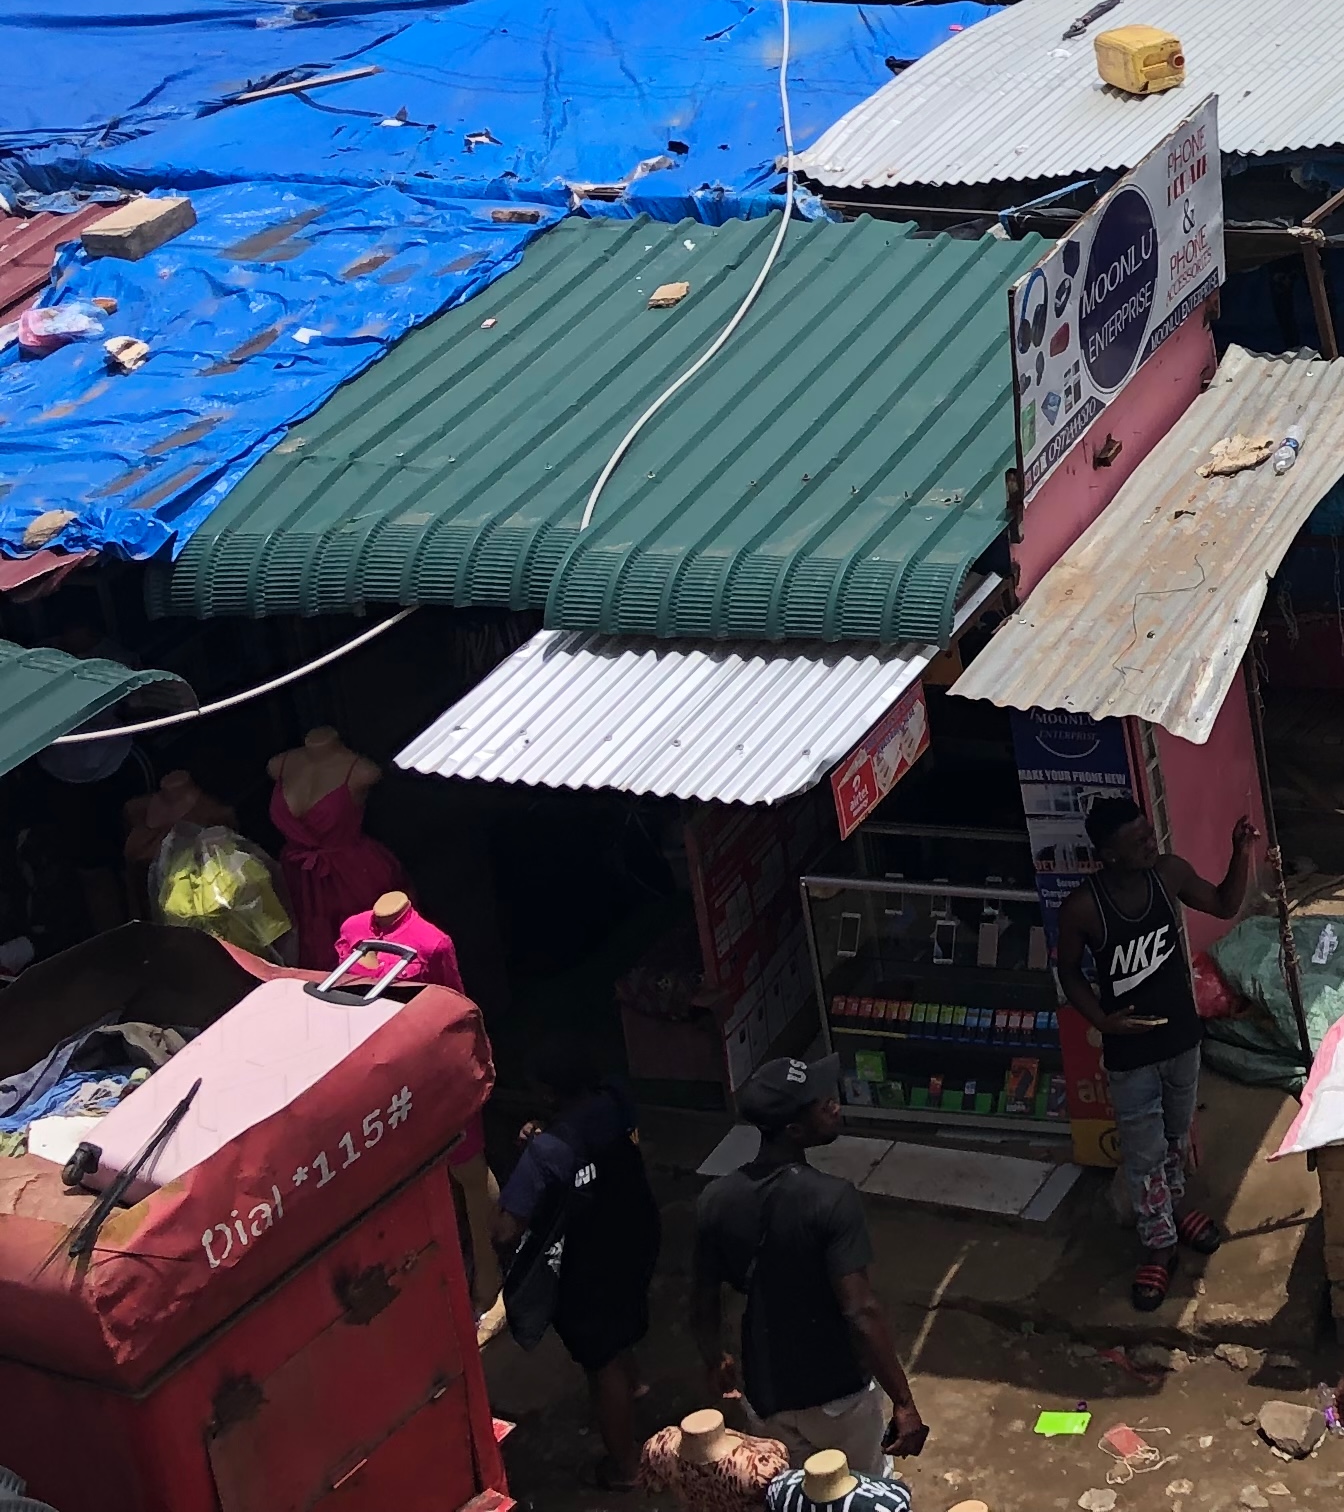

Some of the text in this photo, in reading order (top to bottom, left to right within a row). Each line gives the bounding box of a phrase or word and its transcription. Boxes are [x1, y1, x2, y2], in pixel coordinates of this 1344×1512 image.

[1168, 124, 1207, 178] PHONE
[1181, 198, 1196, 235] &
[1081, 228, 1153, 319] MOONLU
[1166, 247, 1212, 307] ACCESSORIES
[1169, 224, 1208, 281] PHONE
[1088, 281, 1152, 364] ENTERPRISE
[1151, 271, 1219, 351] MOONLU ENTERPRISE
[1035, 712, 1096, 726] MOONLU
[849, 783, 870, 812] airtel
[1018, 769, 1126, 785] MAKE YOUR PHONE NEW
[201, 1185, 284, 1269] Dial
